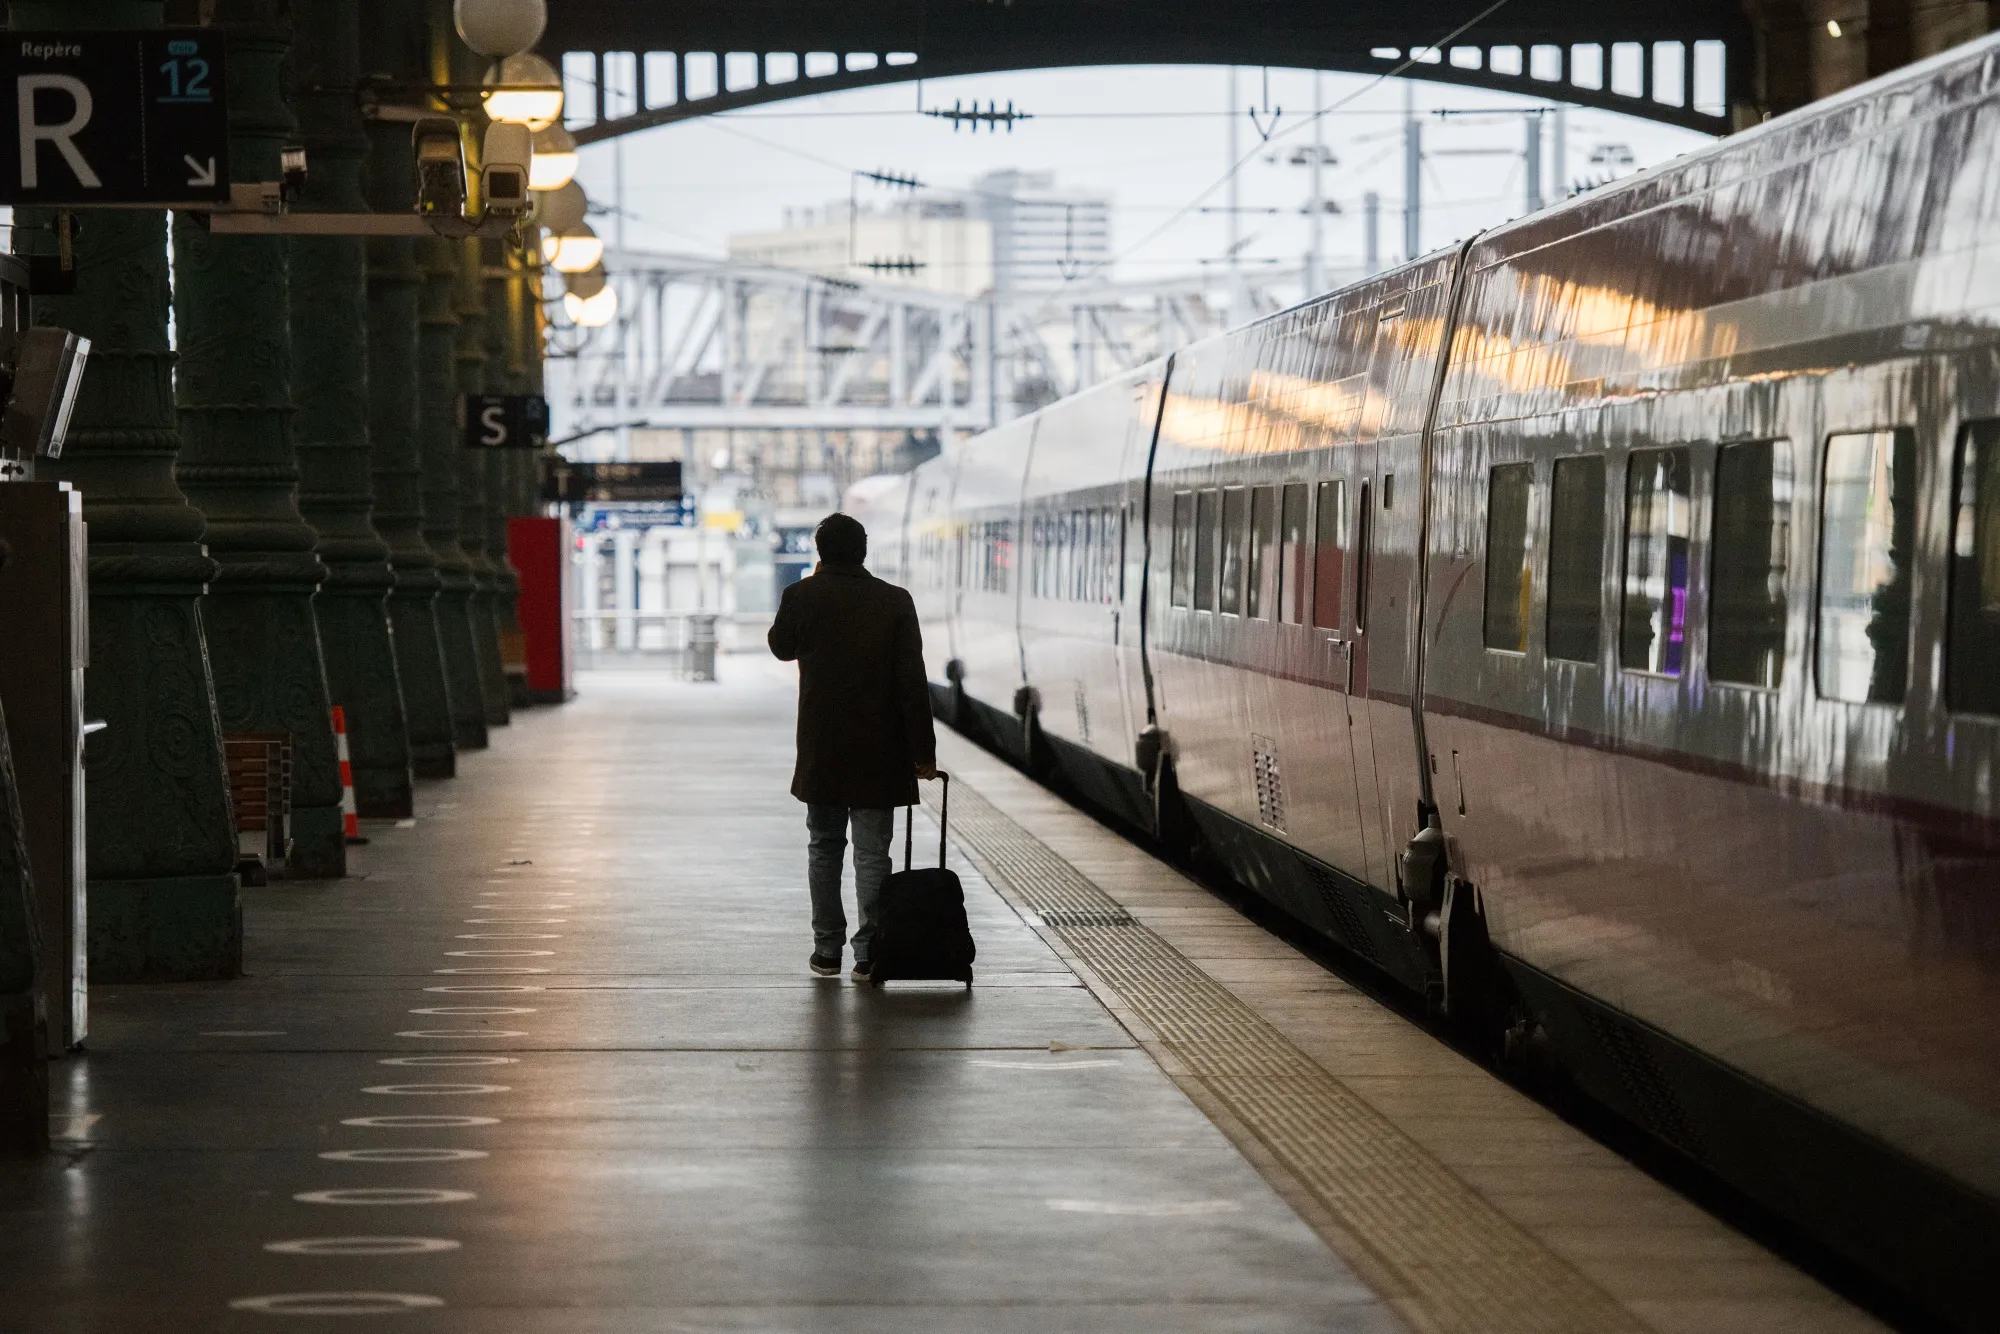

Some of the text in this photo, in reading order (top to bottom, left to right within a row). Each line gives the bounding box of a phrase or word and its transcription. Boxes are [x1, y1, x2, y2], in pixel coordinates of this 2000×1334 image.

[21, 42, 81, 60] Repère
[159, 59, 210, 96] 12
[17, 74, 102, 188] R
[481, 406, 507, 445] S
